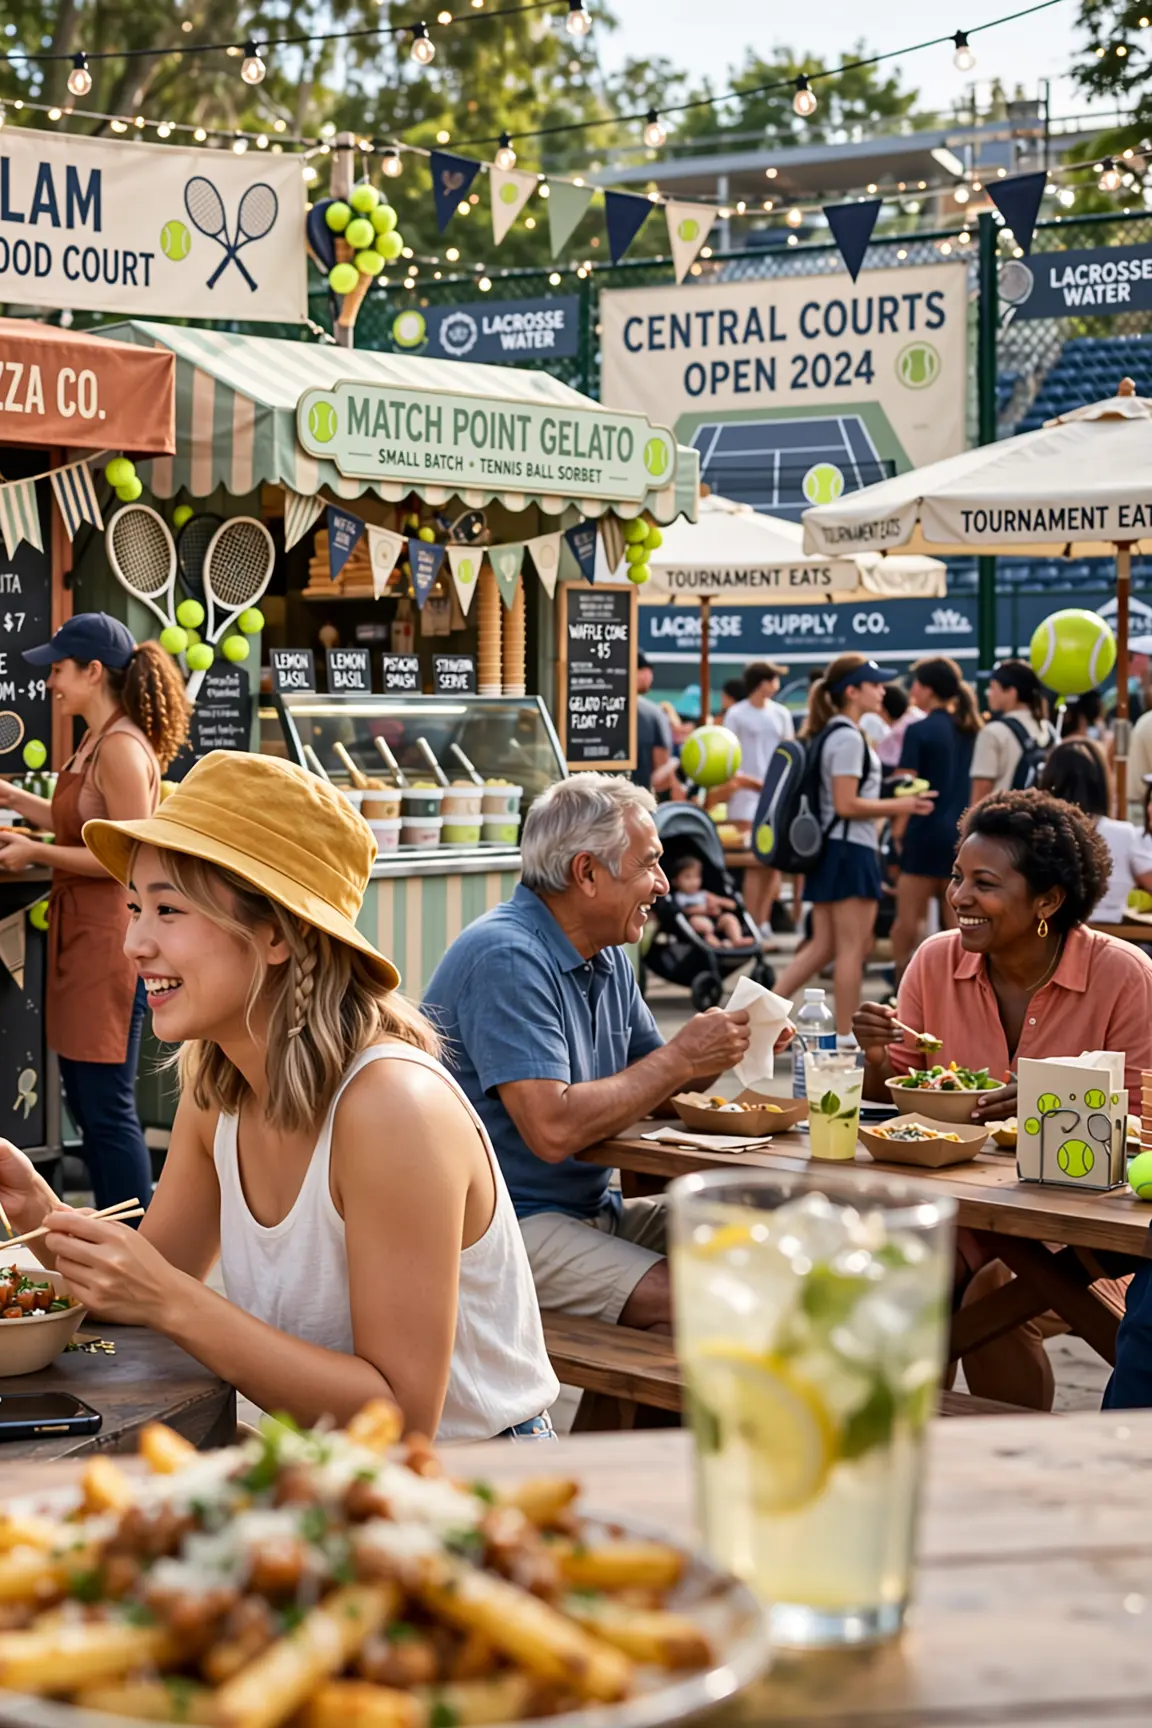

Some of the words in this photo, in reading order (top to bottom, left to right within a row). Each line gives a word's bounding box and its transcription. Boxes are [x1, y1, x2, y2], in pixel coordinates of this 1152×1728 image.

[63, 244, 155, 287] COURT
[1050, 258, 1152, 288] LACROSSE
[1063, 283, 1131, 307] WATER
[482, 310, 565, 335] LACROSSE
[623, 307, 787, 352] CENTRAL
[798, 291, 947, 339] COURTS
[500, 330, 555, 351] WATER
[683, 357, 779, 397] OPEN
[789, 349, 876, 390] 2024
[57, 369, 106, 422] CO.
[348, 396, 442, 444] MATCH
[453, 407, 531, 452] POINT
[540, 417, 634, 463] GELATO
[379, 449, 420, 468] SMALL
[424, 452, 464, 471] BATCH
[480, 458, 522, 476] TENNIS
[526, 463, 554, 480] BALL
[558, 466, 602, 484] SORBET
[961, 505, 1109, 533] TOURNAMENT
[666, 569, 782, 588] TOURNAMENT
[789, 568, 831, 585] EATS
[3, 613, 26, 633] $7
[568, 624, 603, 640] WAFFLE
[762, 613, 838, 636] SUPPLY
[852, 612, 890, 635] CO.
[274, 653, 309, 669] LEMON
[330, 653, 366, 670] LEMON
[597, 642, 611, 659] $5
[27, 679, 46, 700] $9
[279, 671, 310, 688] BASIL
[334, 671, 365, 688] BASIL
[572, 714, 598, 729] FLOAT
[606, 714, 619, 728] $7
